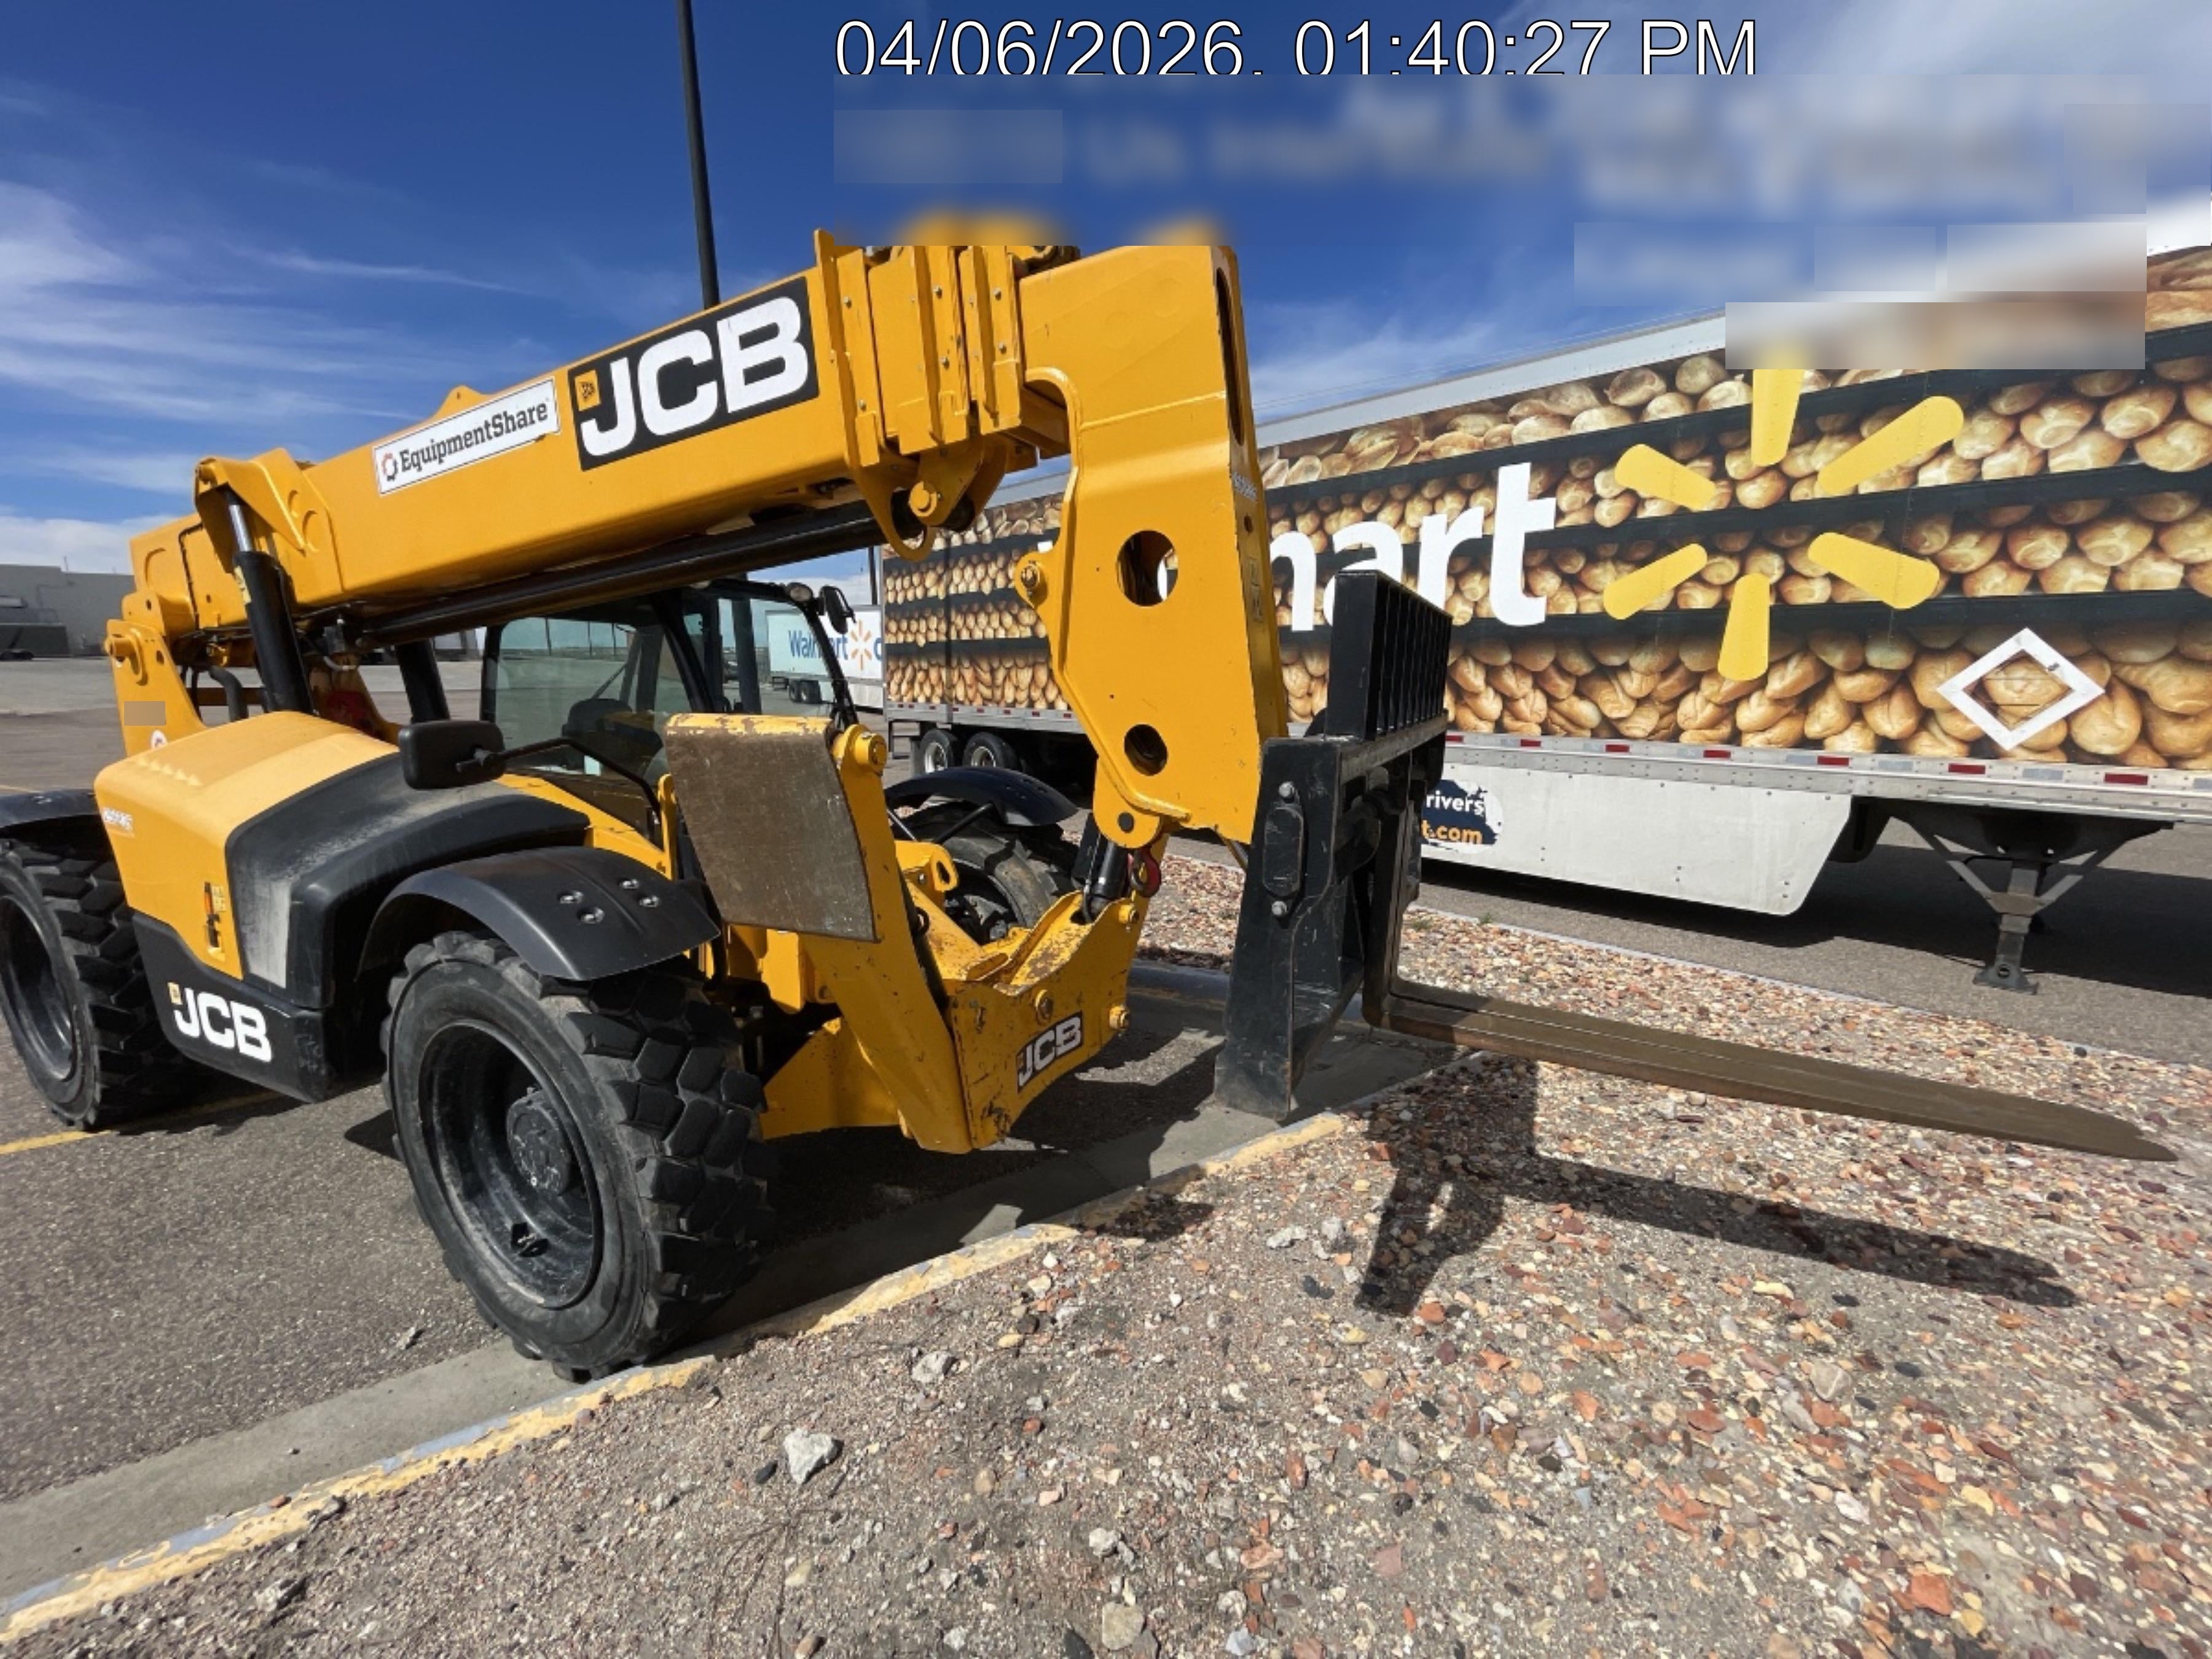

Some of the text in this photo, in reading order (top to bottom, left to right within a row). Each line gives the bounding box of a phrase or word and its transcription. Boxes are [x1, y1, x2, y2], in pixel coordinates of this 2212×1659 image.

[580, 296, 809, 456] JCB
[399, 402, 548, 472] EquipmentShare
[788, 629, 849, 661] Walrt
[174, 987, 272, 1062] JCB
[1018, 1016, 1081, 1086] JCB
